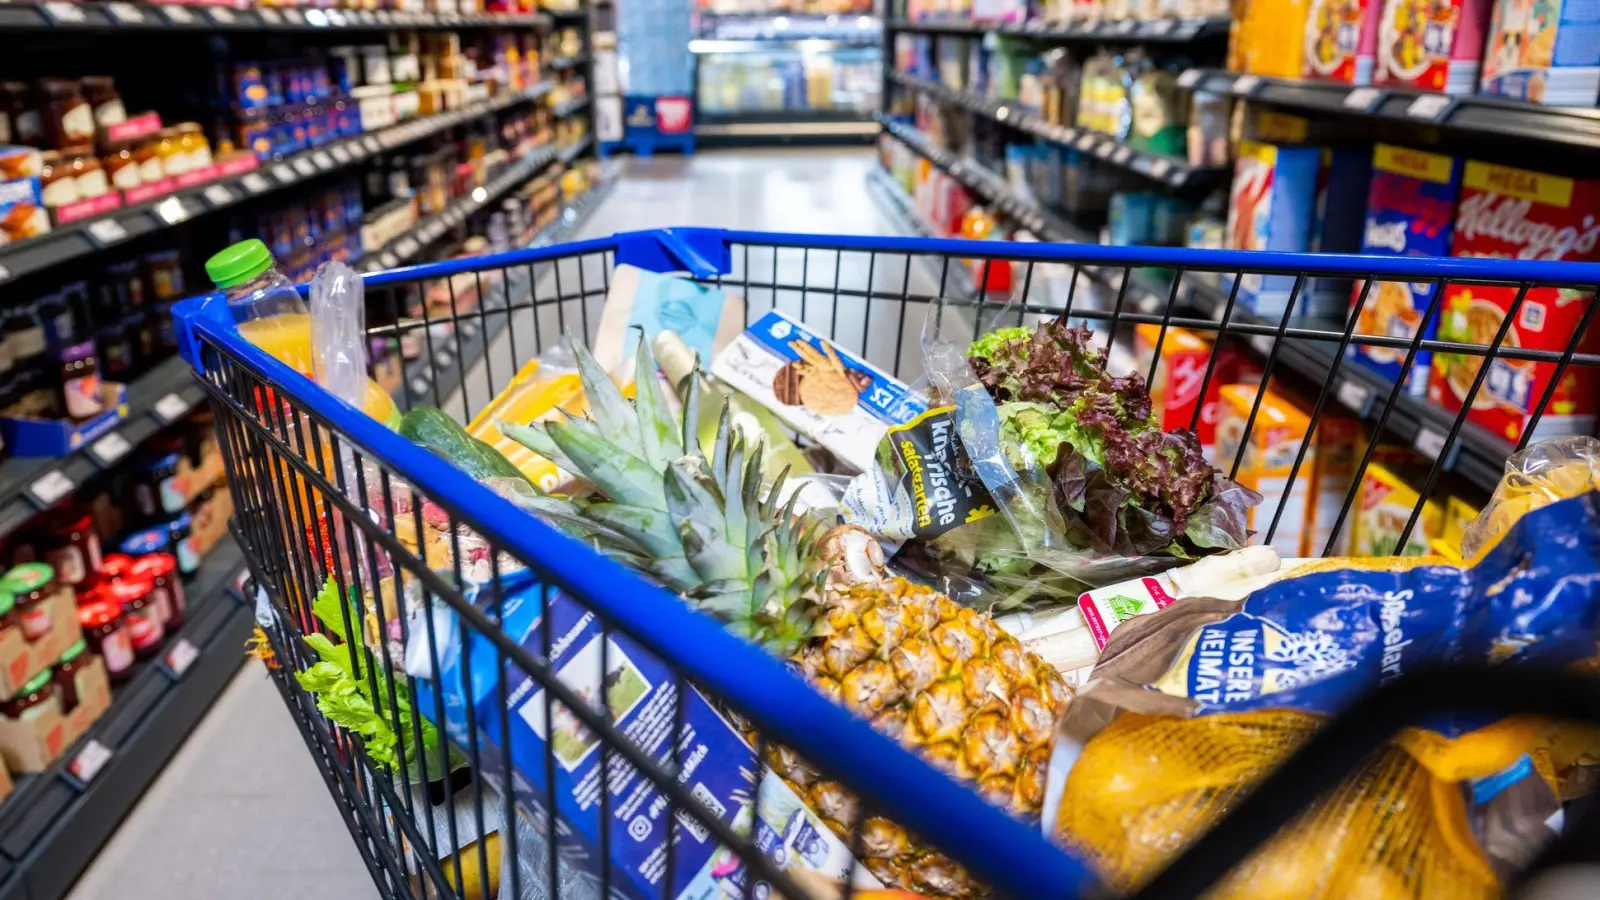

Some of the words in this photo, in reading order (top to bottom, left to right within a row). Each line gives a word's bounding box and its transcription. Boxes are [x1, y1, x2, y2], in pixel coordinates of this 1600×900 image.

[1487, 166, 1539, 194] MEGA
[1455, 190, 1600, 262] Kellogg's
[901, 440, 932, 527] salatgarten
[1195, 629, 1229, 703] HEIMAT
